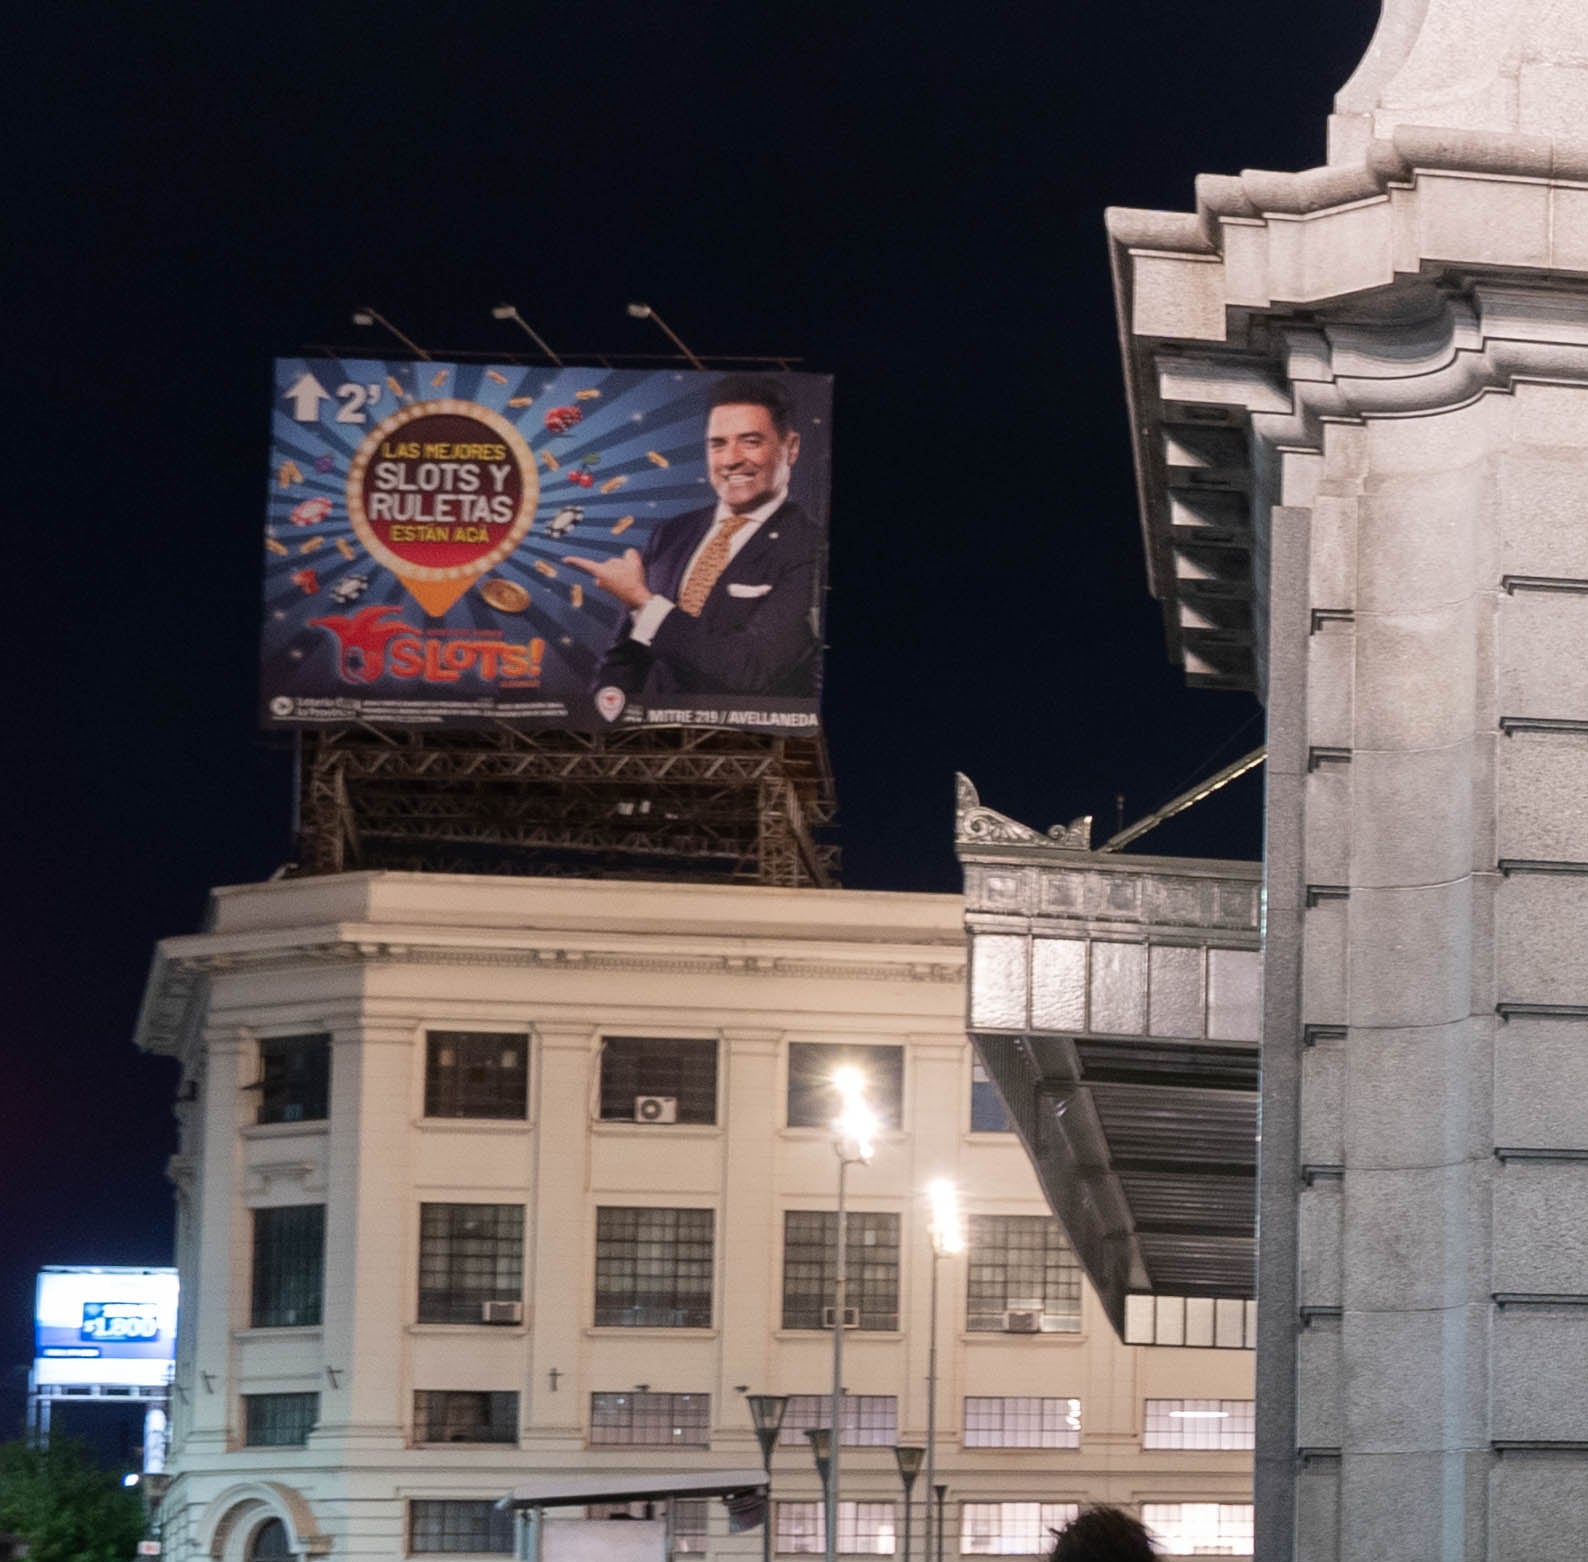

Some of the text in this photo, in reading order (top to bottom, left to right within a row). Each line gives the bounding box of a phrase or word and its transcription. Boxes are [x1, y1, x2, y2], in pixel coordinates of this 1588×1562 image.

[382, 442, 507, 461] LAS MEJORES
[374, 462, 512, 492] SLOTS Y
[368, 492, 514, 524] RULETAS
[727, 711, 819, 727] AVELLANEDA
